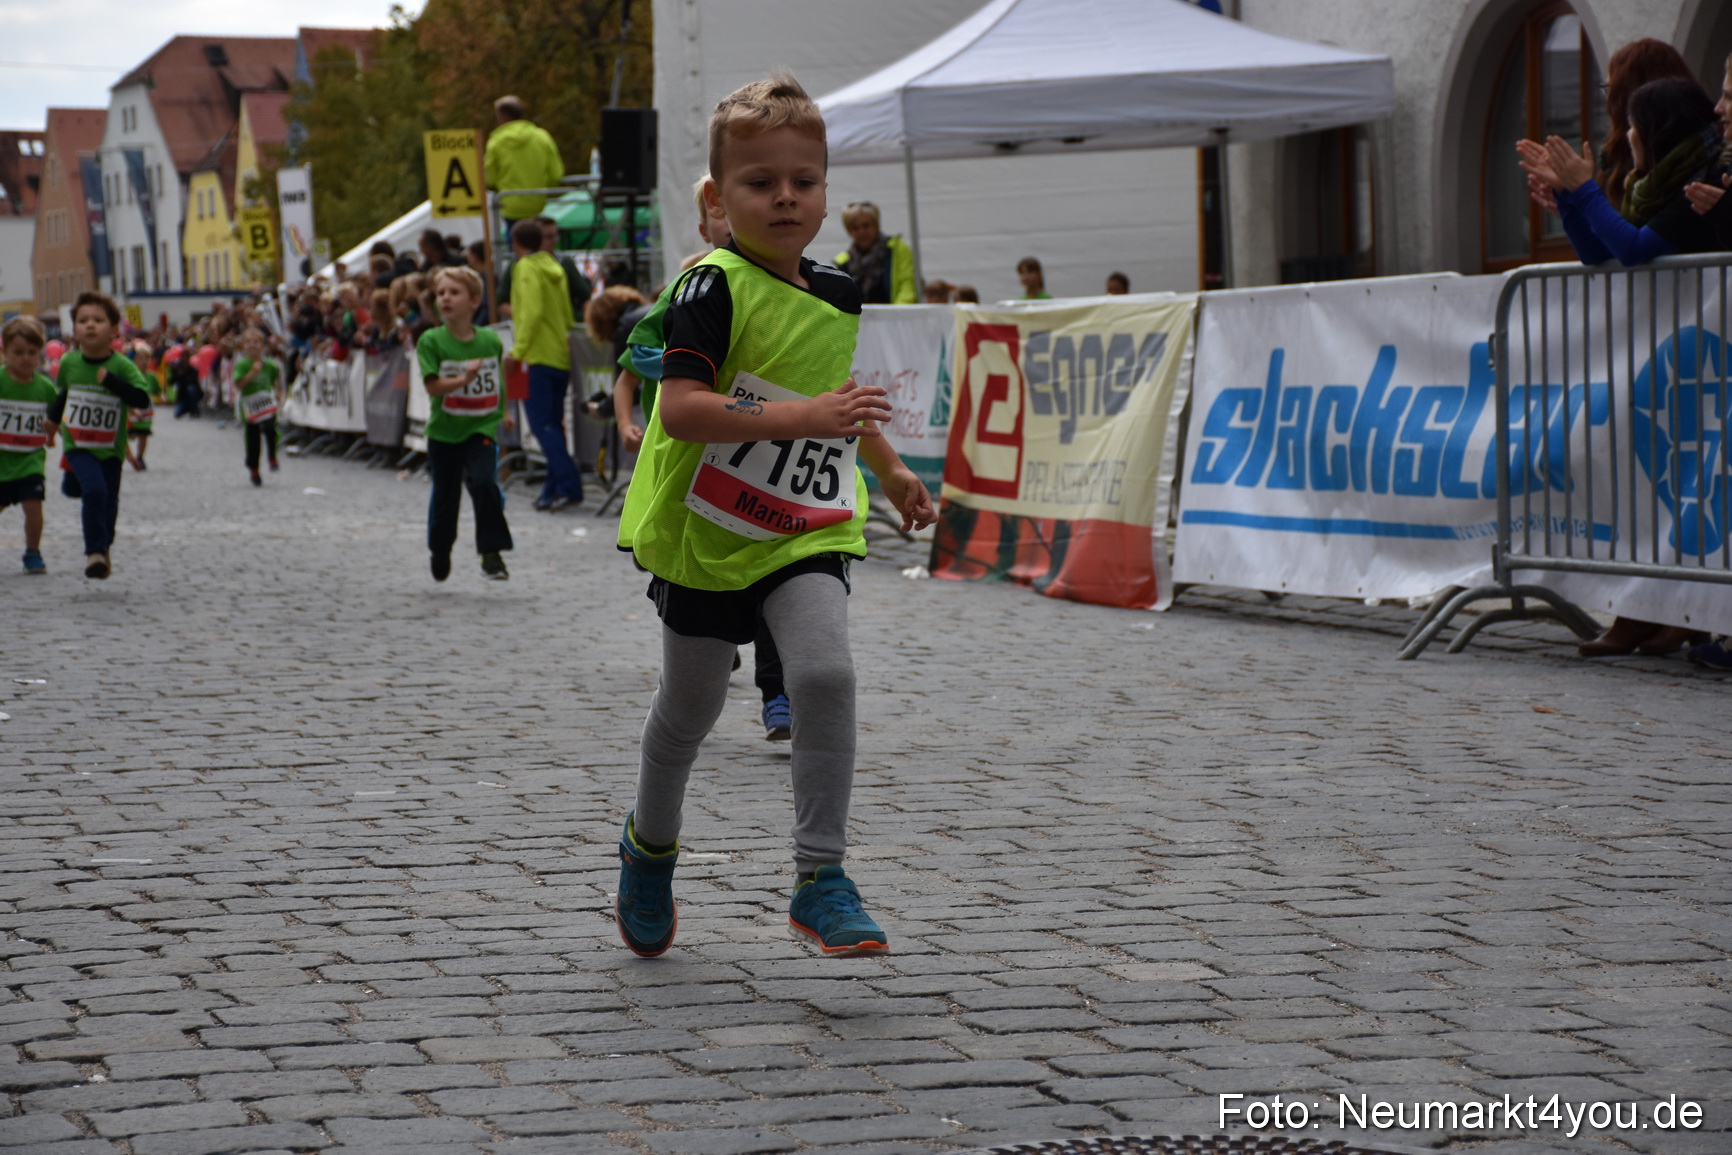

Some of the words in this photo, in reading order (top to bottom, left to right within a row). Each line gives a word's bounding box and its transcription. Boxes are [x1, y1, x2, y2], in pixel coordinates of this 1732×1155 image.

[430, 133, 474, 151] Block
[442, 157, 474, 198] A
[250, 223, 270, 250] B
[1024, 331, 1169, 444] Egner
[1, 411, 44, 433] 7149
[69, 404, 117, 429] 7030
[734, 490, 808, 532] Marian
